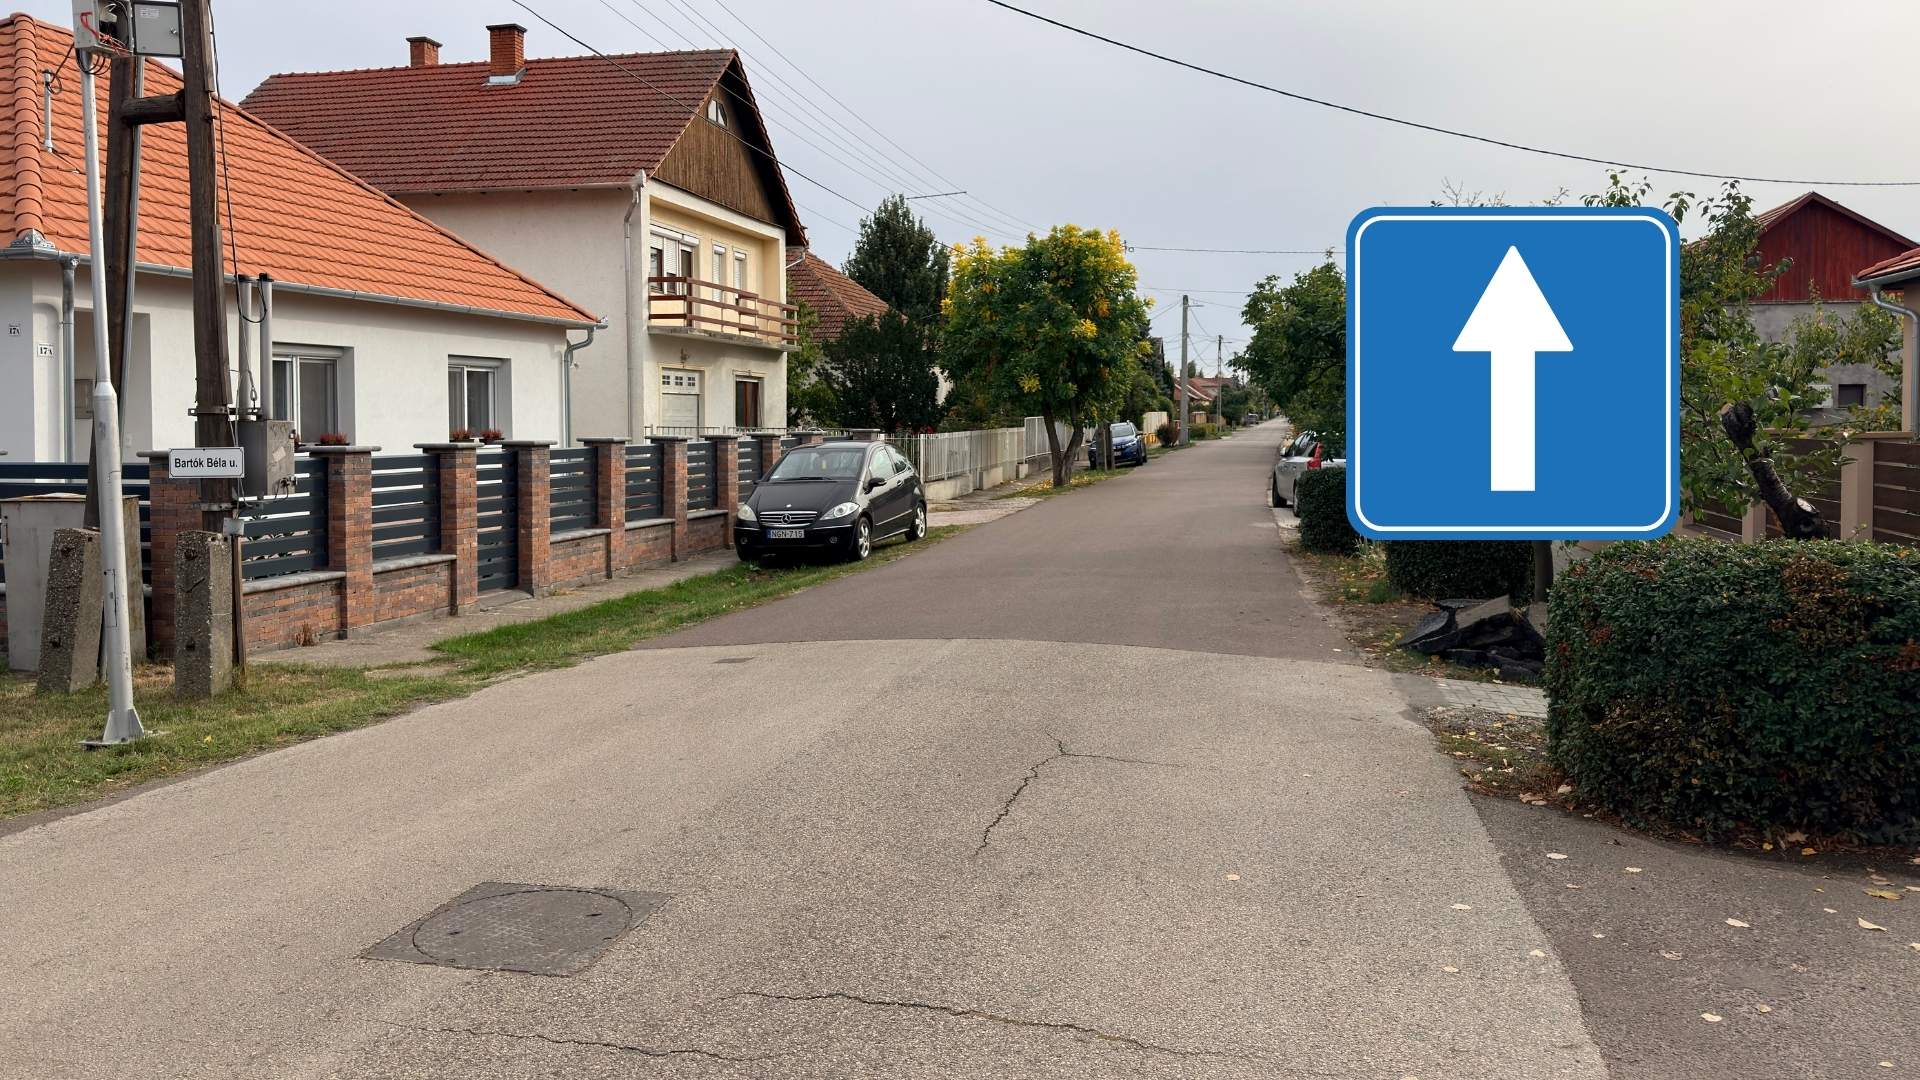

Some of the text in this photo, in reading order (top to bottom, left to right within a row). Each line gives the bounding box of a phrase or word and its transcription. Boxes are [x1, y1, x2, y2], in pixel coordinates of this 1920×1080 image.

[174, 457, 238, 468] Bartók Béla u.
[770, 530, 804, 538] NGN-715
